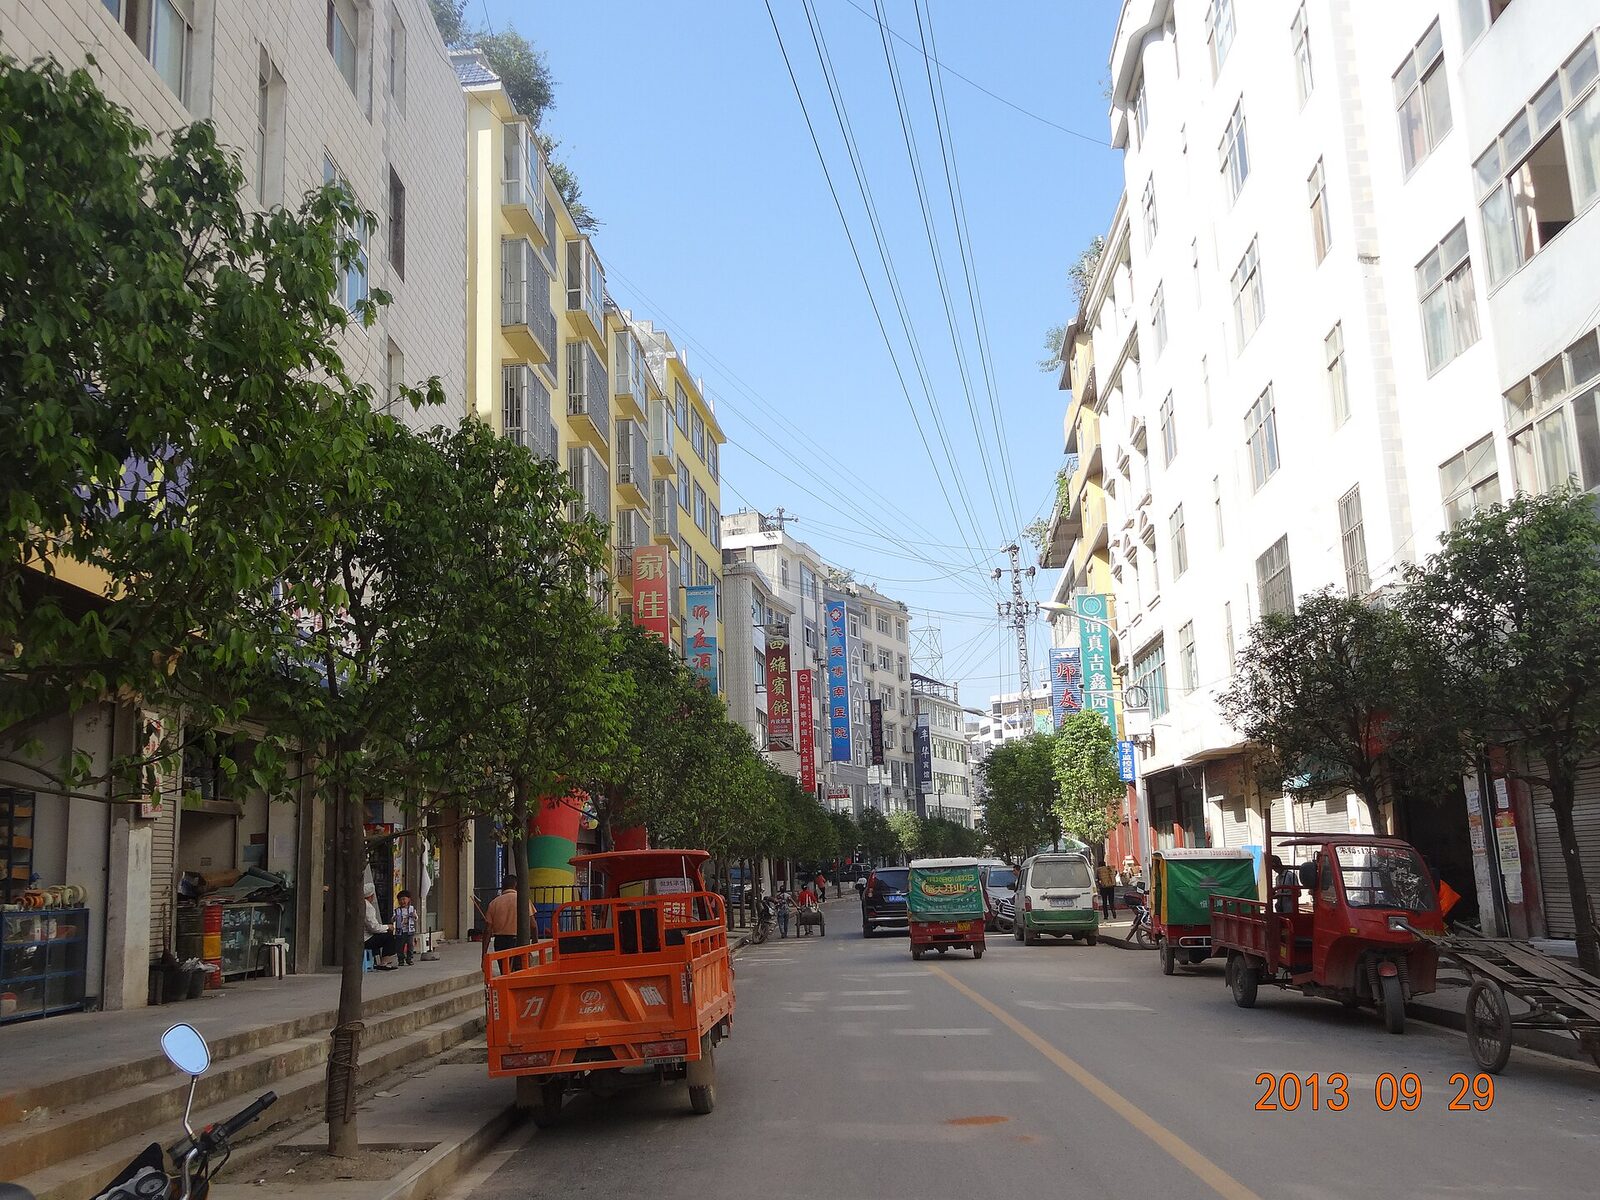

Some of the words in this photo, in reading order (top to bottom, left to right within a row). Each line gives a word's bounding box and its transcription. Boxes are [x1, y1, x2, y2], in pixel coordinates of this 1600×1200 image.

[1055, 663, 1079, 729] 师友
[1121, 742, 1134, 780] 电子监控区域
[520, 996, 544, 1018] 力
[578, 1004, 605, 1015] LIFAN
